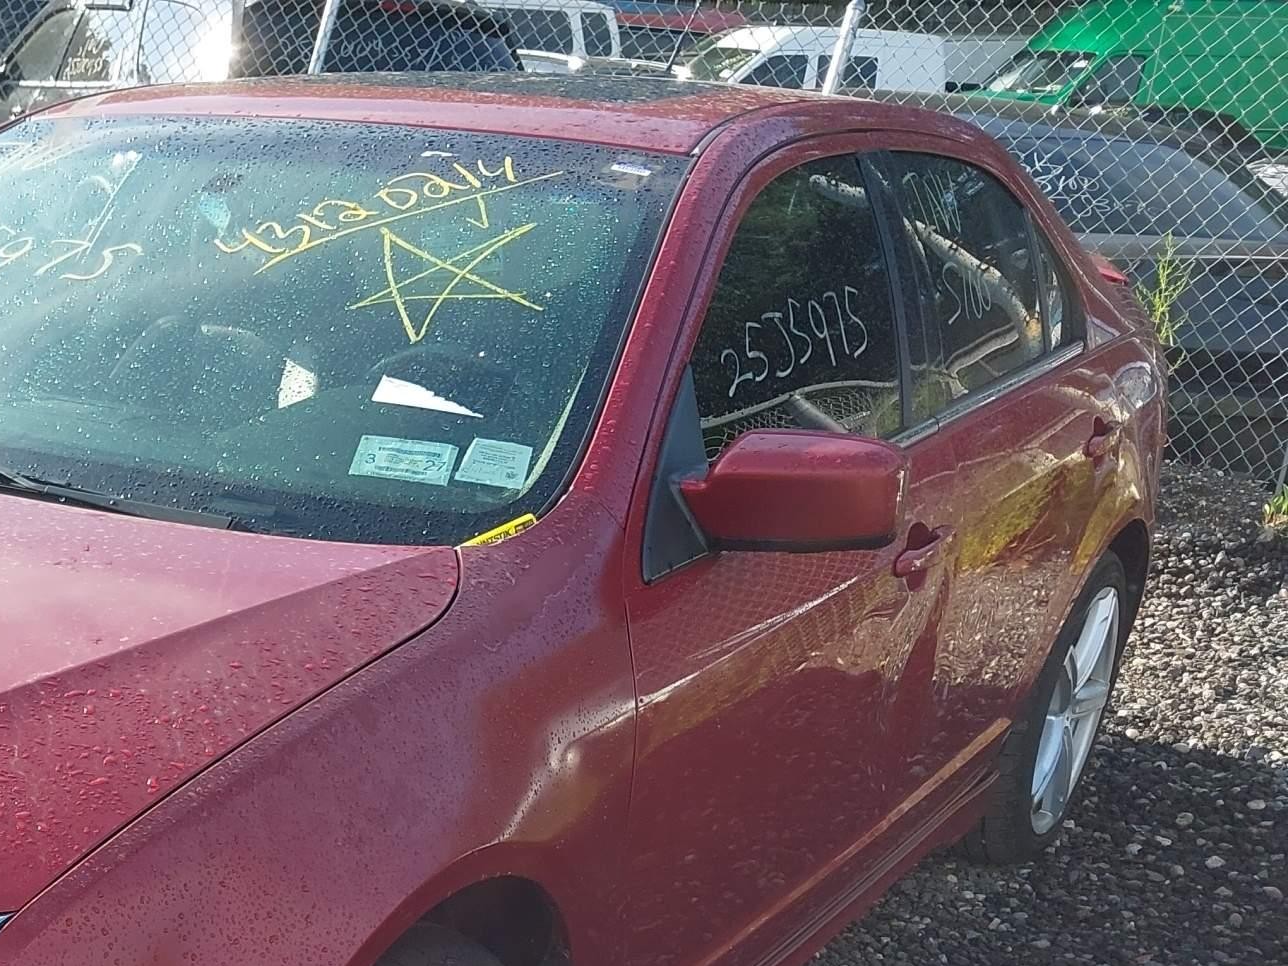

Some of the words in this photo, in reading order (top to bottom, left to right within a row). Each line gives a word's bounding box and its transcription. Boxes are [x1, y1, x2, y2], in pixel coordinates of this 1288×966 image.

[720, 285, 869, 398] 25J5975
[364, 453, 377, 465] 3
[423, 459, 447, 472] 27
